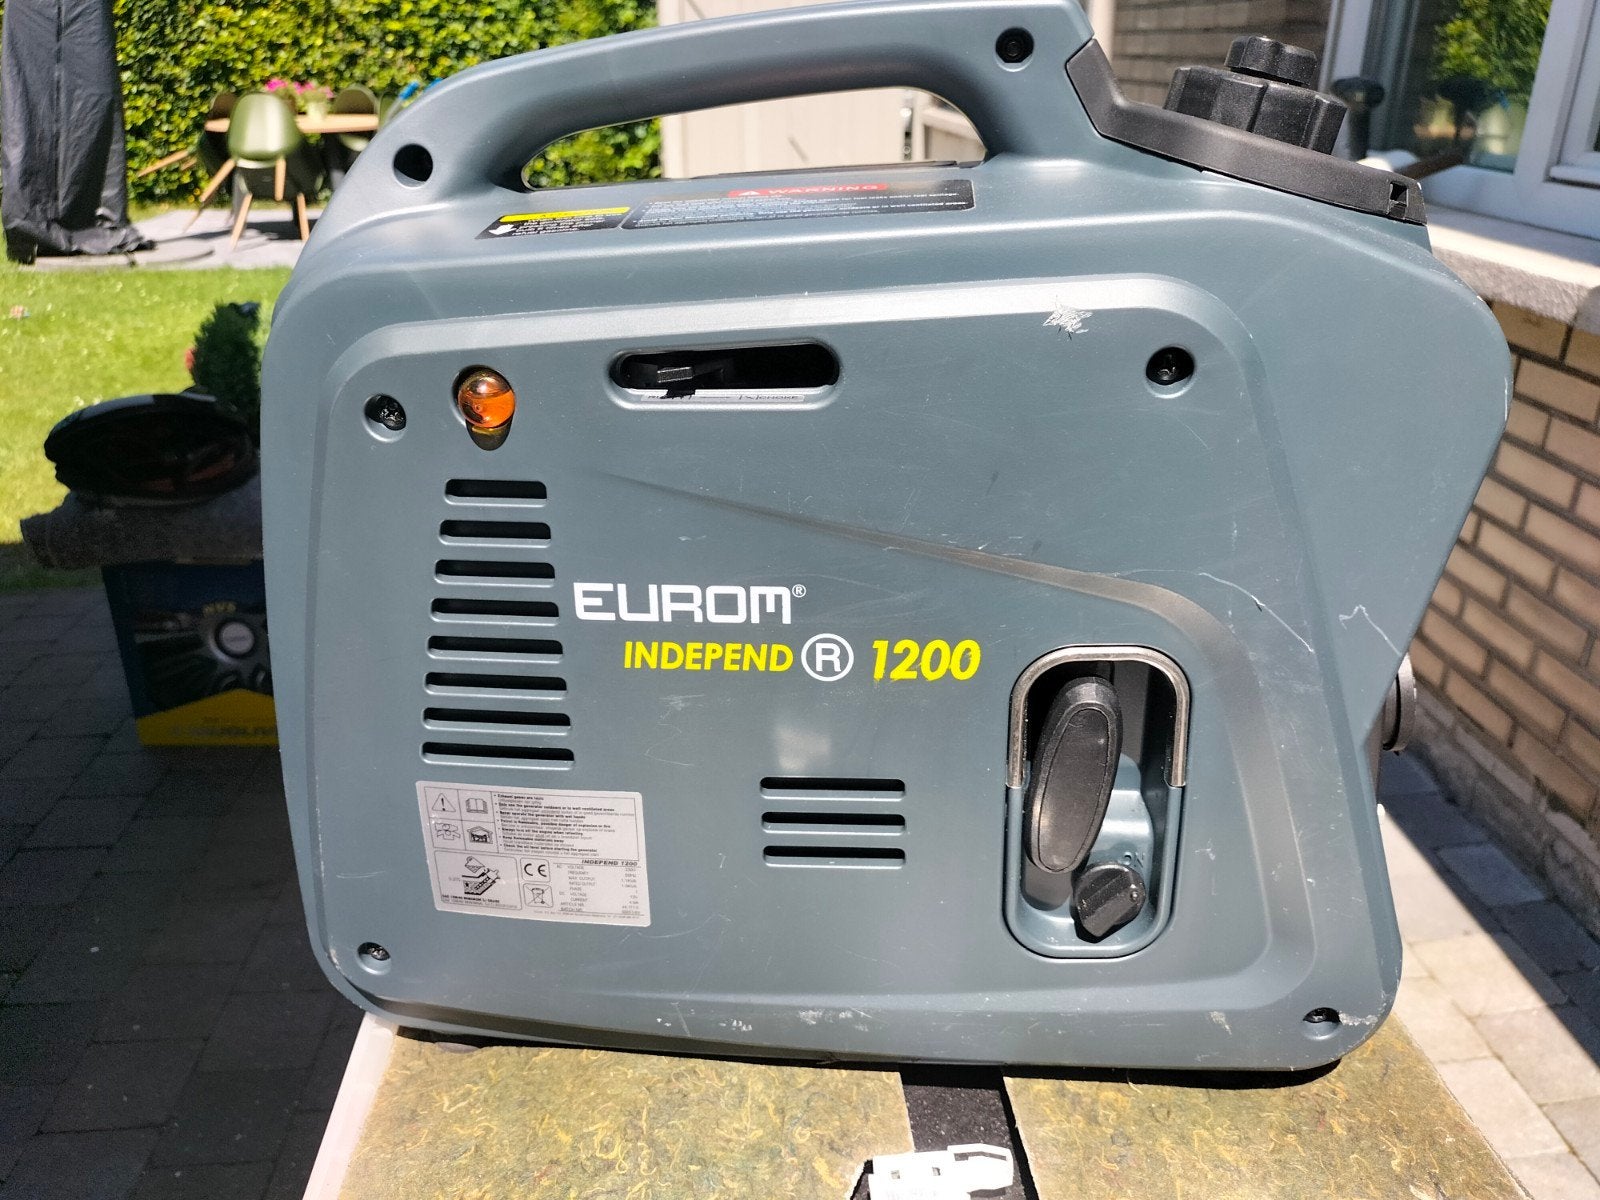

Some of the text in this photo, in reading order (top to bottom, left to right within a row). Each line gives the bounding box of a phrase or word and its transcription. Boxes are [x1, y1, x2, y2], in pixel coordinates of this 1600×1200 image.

[768, 184, 878, 194] WARNING
[624, 640, 794, 672] INDEPEND
[872, 639, 982, 681] 1200
